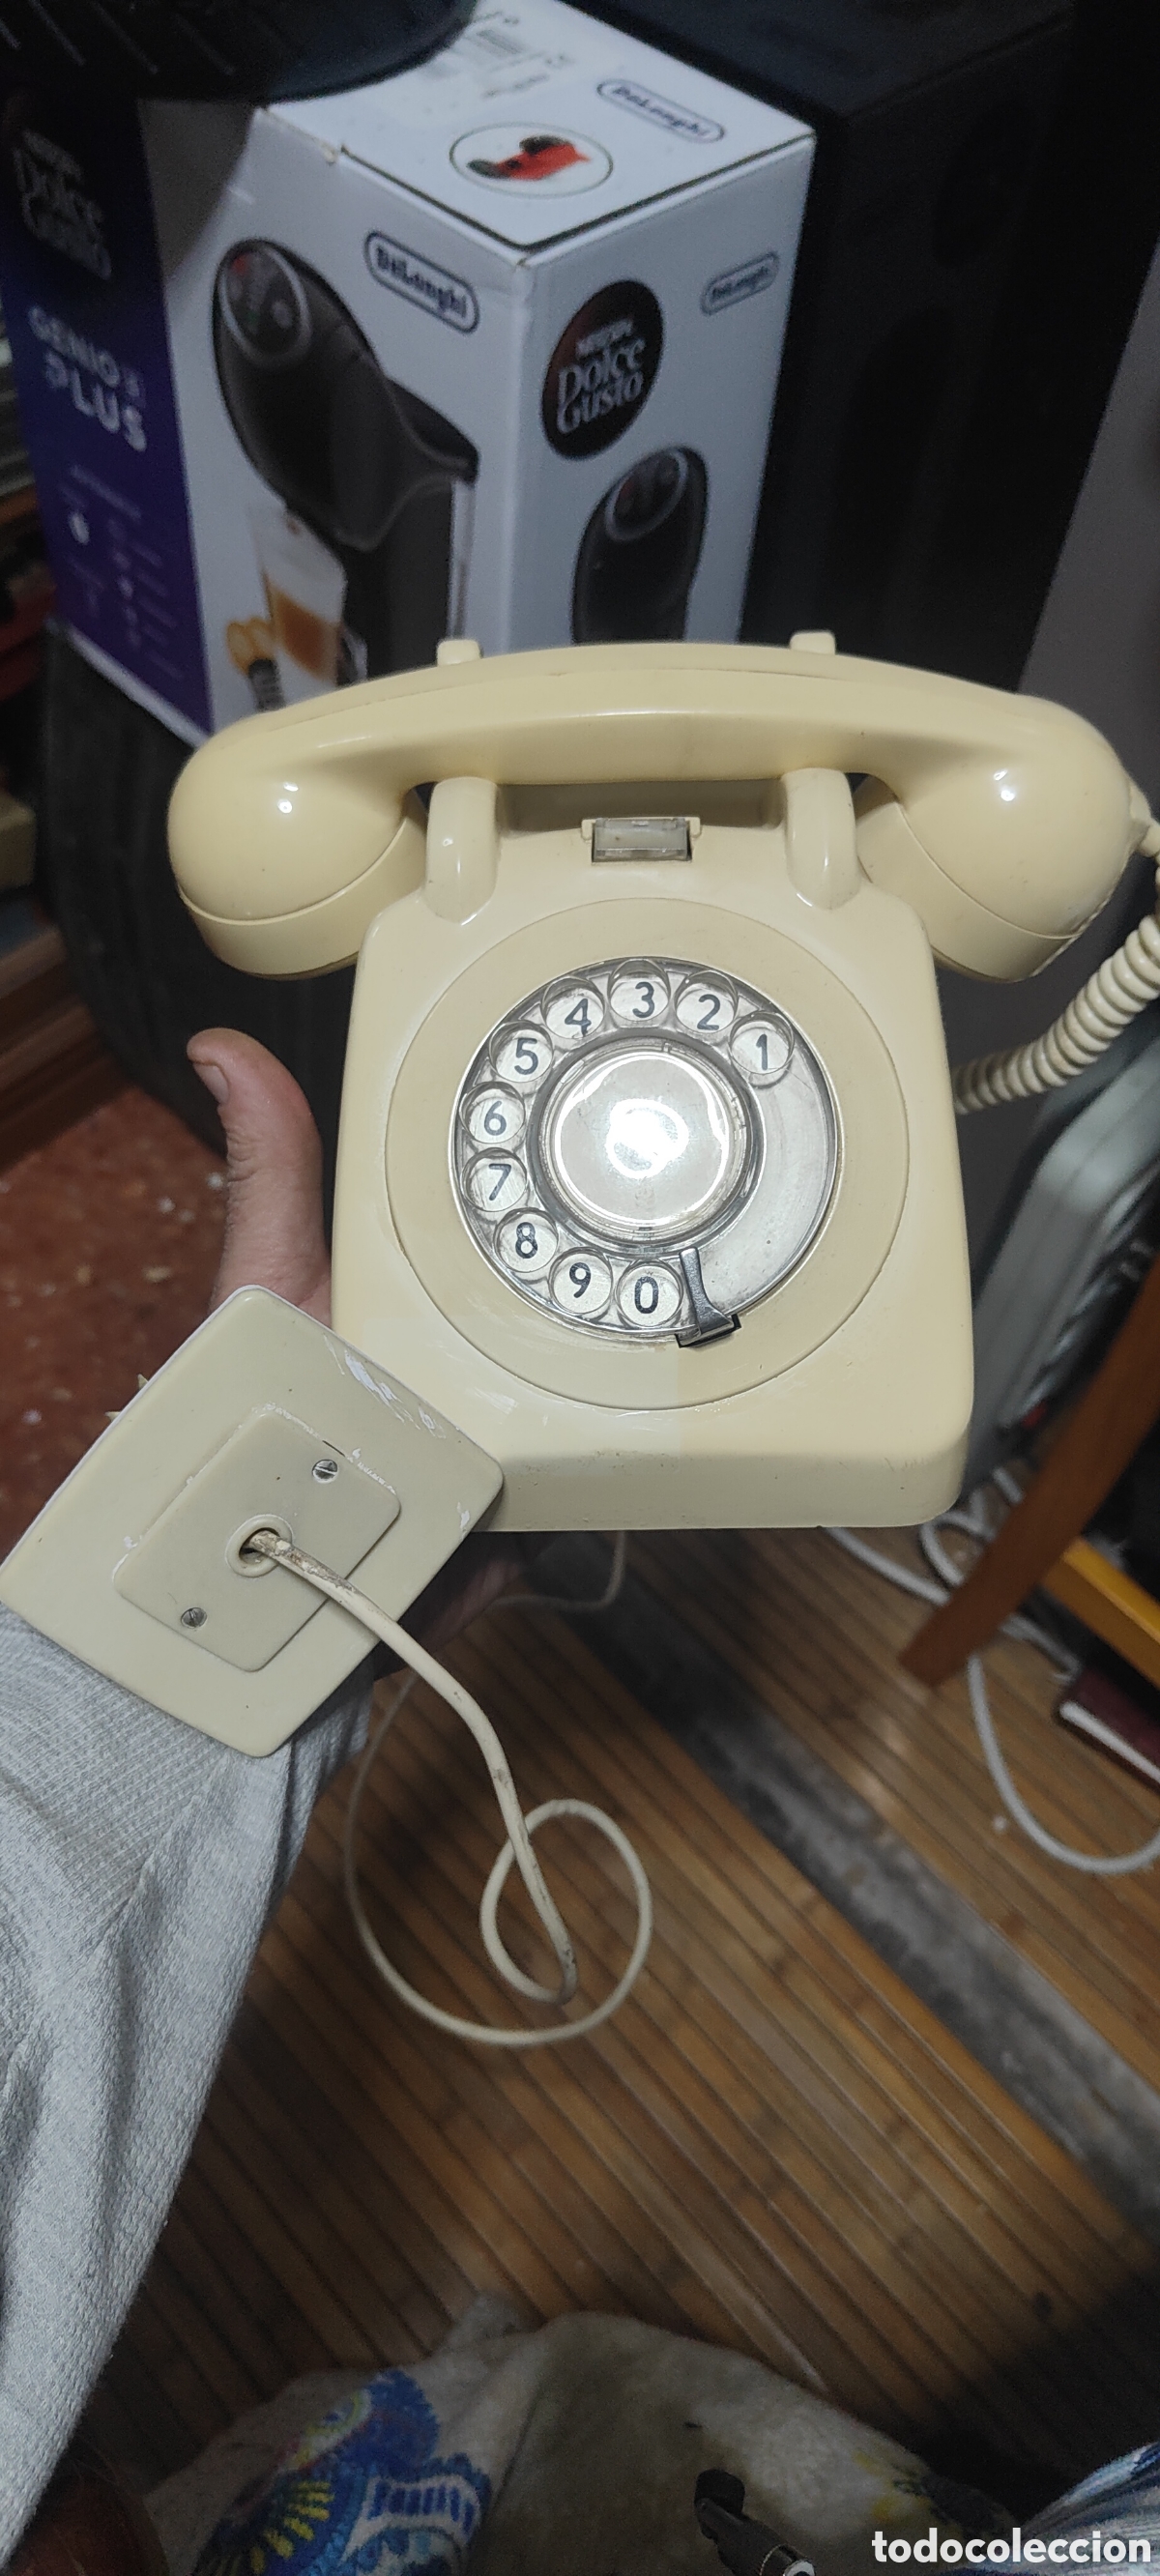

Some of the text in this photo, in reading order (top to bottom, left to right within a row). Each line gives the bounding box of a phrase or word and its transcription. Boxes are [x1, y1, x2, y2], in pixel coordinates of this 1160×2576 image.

[558, 338, 646, 406] Dolce
[557, 369, 644, 434] Gusto
[564, 999, 592, 1034] 4
[632, 981, 655, 1019] 3
[697, 994, 721, 1031] 2
[514, 1037, 539, 1075] 5
[755, 1033, 768, 1071] 1
[483, 1100, 508, 1137] 6
[488, 1163, 512, 1201] 7
[514, 1222, 539, 1259] 8
[568, 1262, 592, 1298] 9
[634, 1276, 659, 1315] 0
